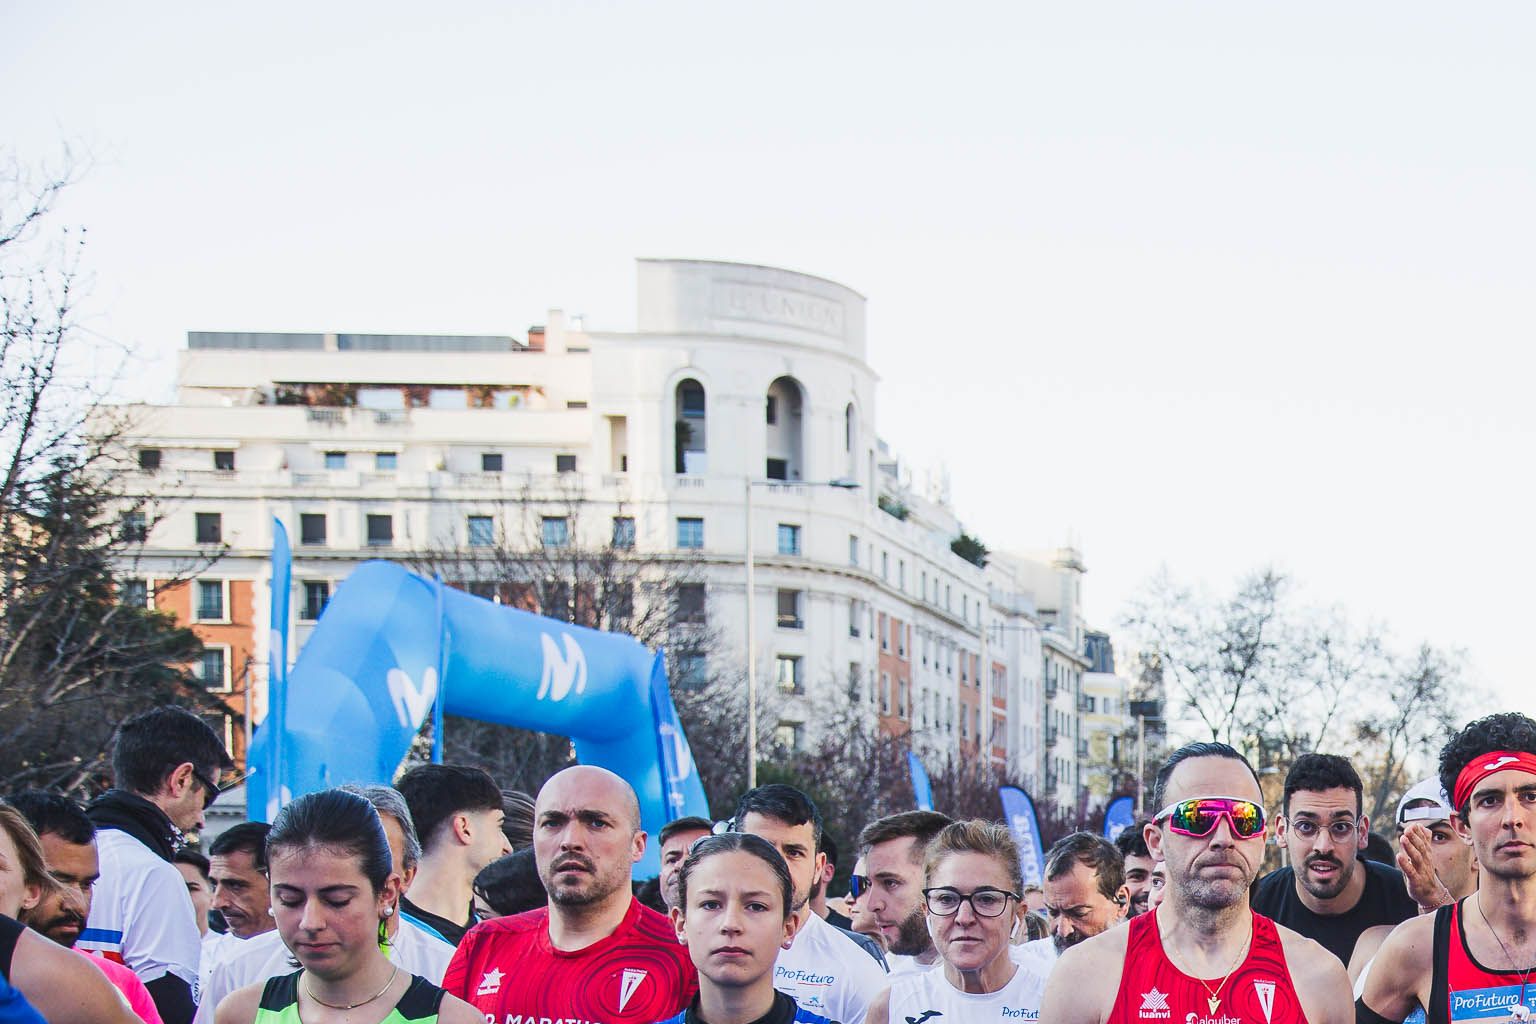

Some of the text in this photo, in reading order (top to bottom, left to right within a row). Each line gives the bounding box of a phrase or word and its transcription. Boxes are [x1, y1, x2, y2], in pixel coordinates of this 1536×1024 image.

[775, 966, 835, 984] ProFuturo
[1454, 992, 1519, 1011] ProFuturo
[1138, 1009, 1171, 1019] luanvi
